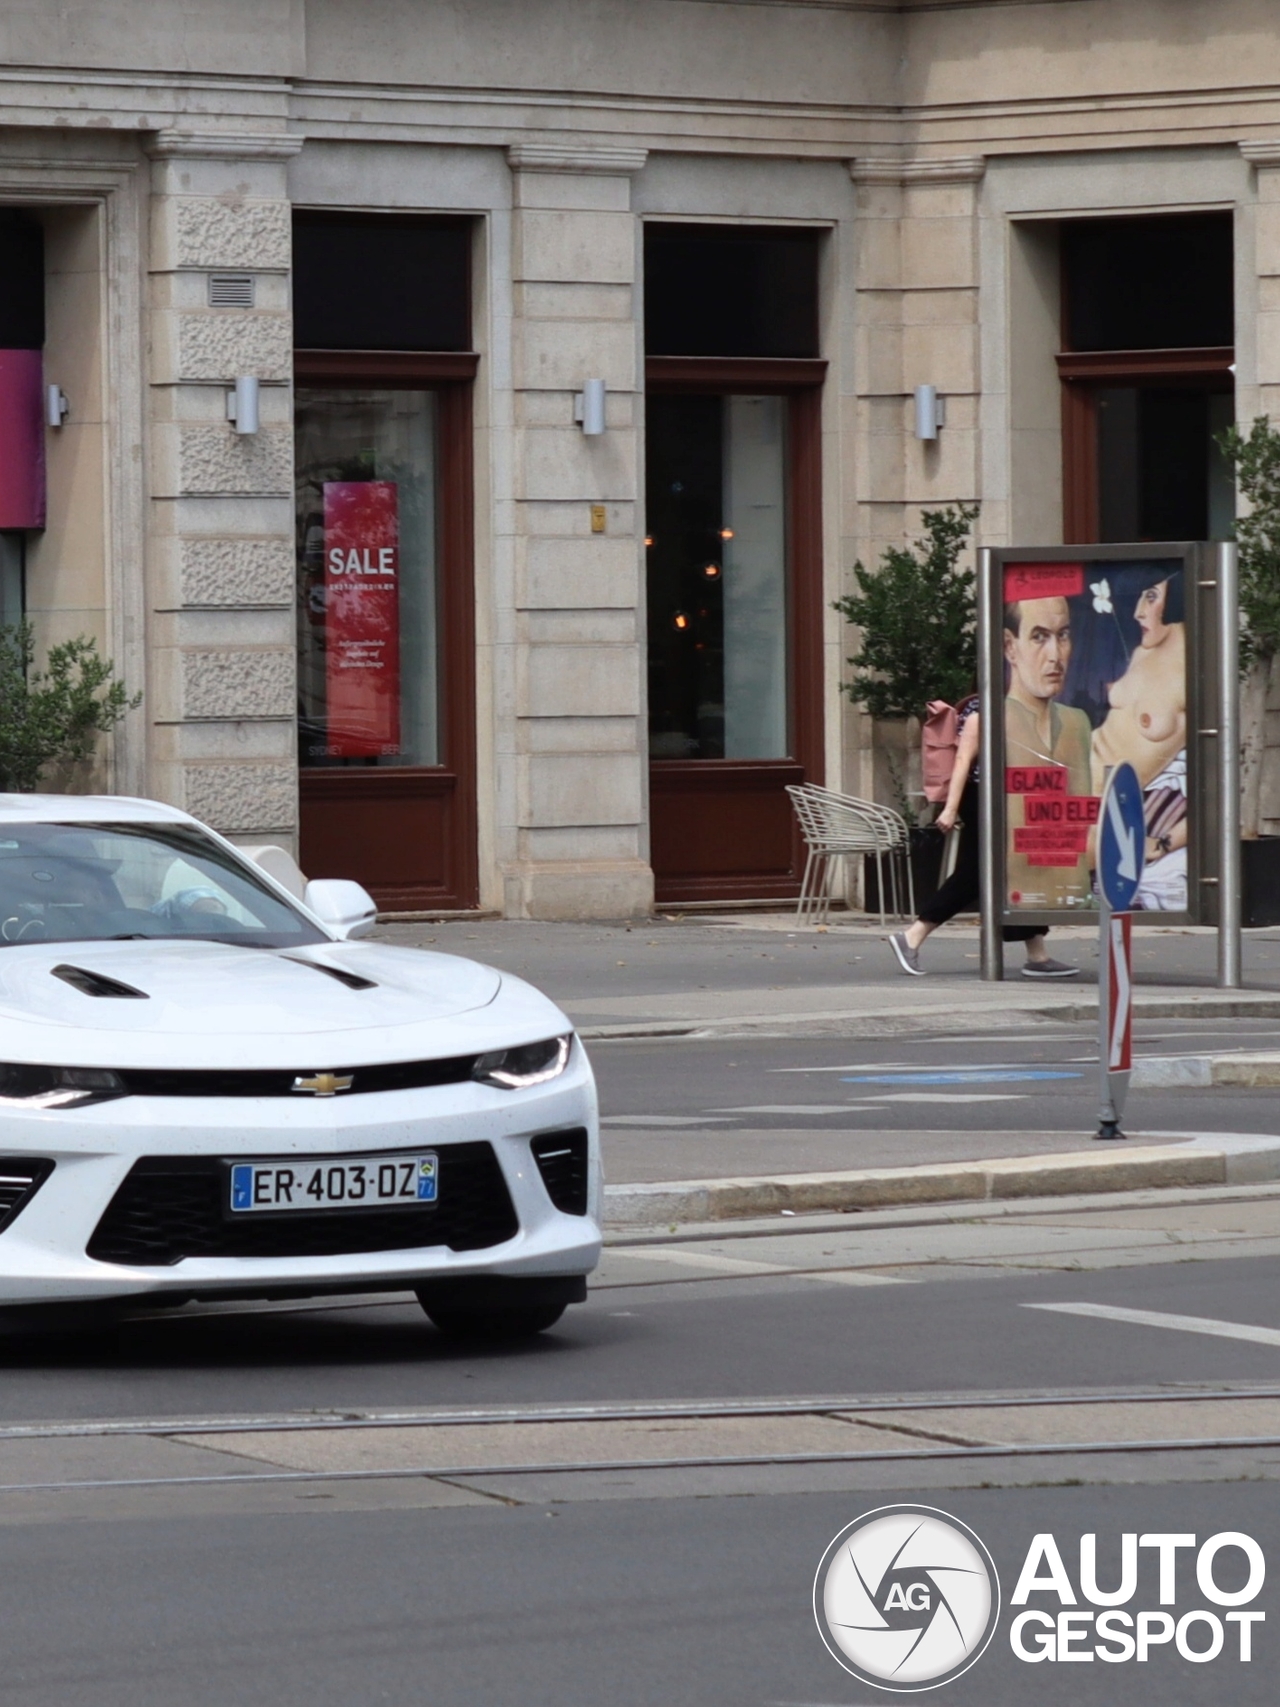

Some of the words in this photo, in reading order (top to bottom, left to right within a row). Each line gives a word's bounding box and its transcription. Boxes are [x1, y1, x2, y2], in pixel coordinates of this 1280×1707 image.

[328, 547, 395, 575] SALE
[308, 745, 342, 756] SYDNEY
[1011, 771, 1063, 791] GLANZ
[1028, 801, 1062, 821] UND
[238, 1191, 246, 1202] F
[419, 1180, 434, 1196] 77
